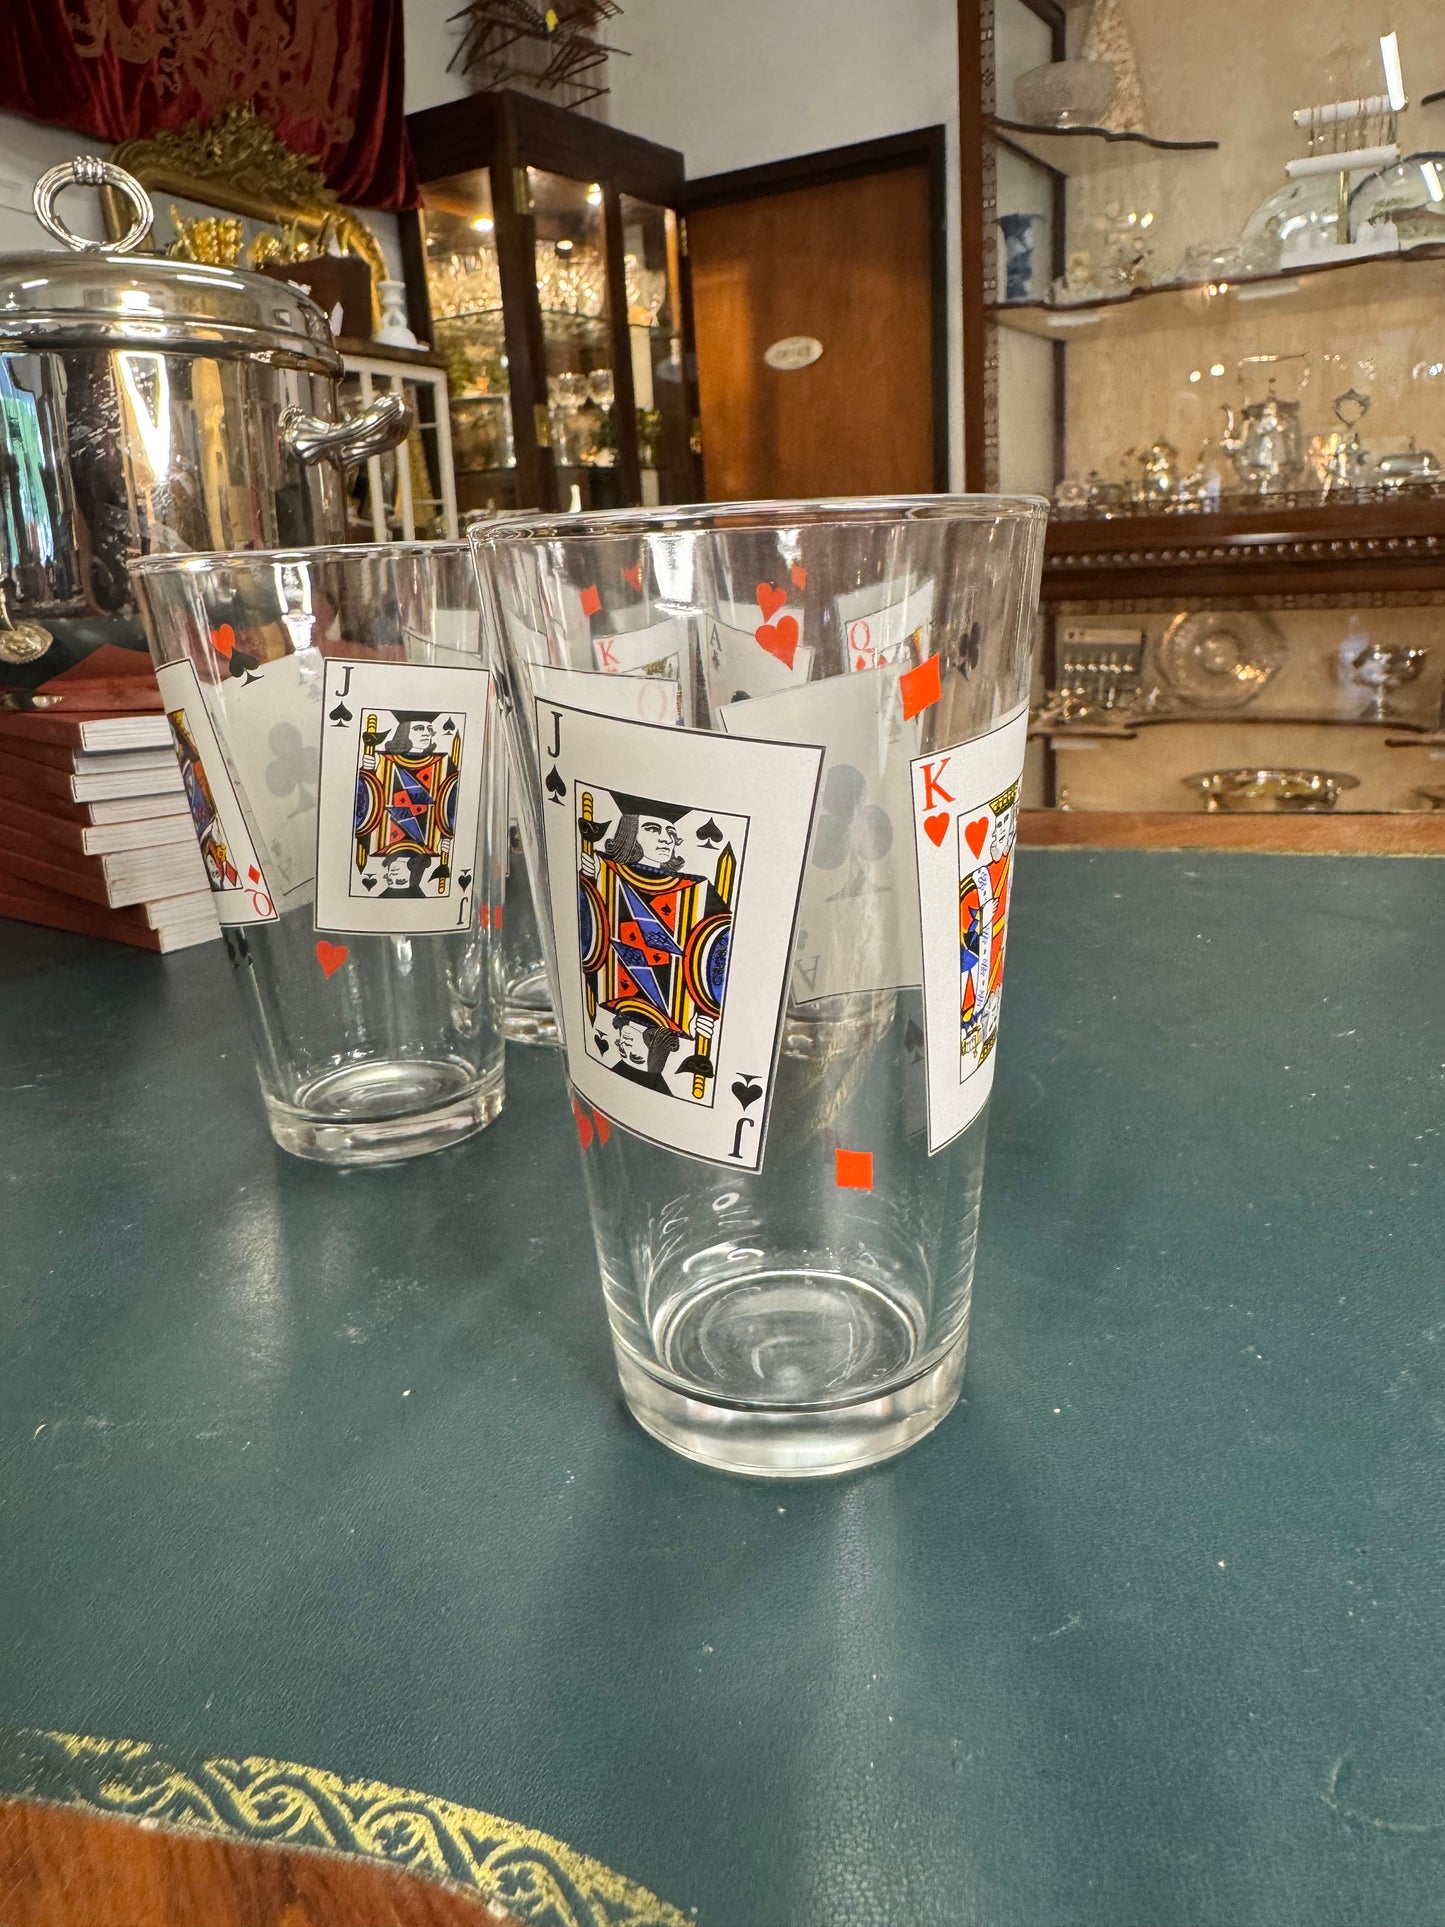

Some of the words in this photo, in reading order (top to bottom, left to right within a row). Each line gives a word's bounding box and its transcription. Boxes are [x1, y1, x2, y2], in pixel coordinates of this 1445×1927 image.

[597, 639, 620, 666] K
[710, 623, 722, 651] A
[850, 621, 874, 654] Q
[335, 666, 355, 697] J
[547, 711, 563, 758] J
[919, 757, 956, 811] K
[244, 888, 272, 917] Q
[456, 897, 469, 925] J
[728, 1117, 754, 1158] J
